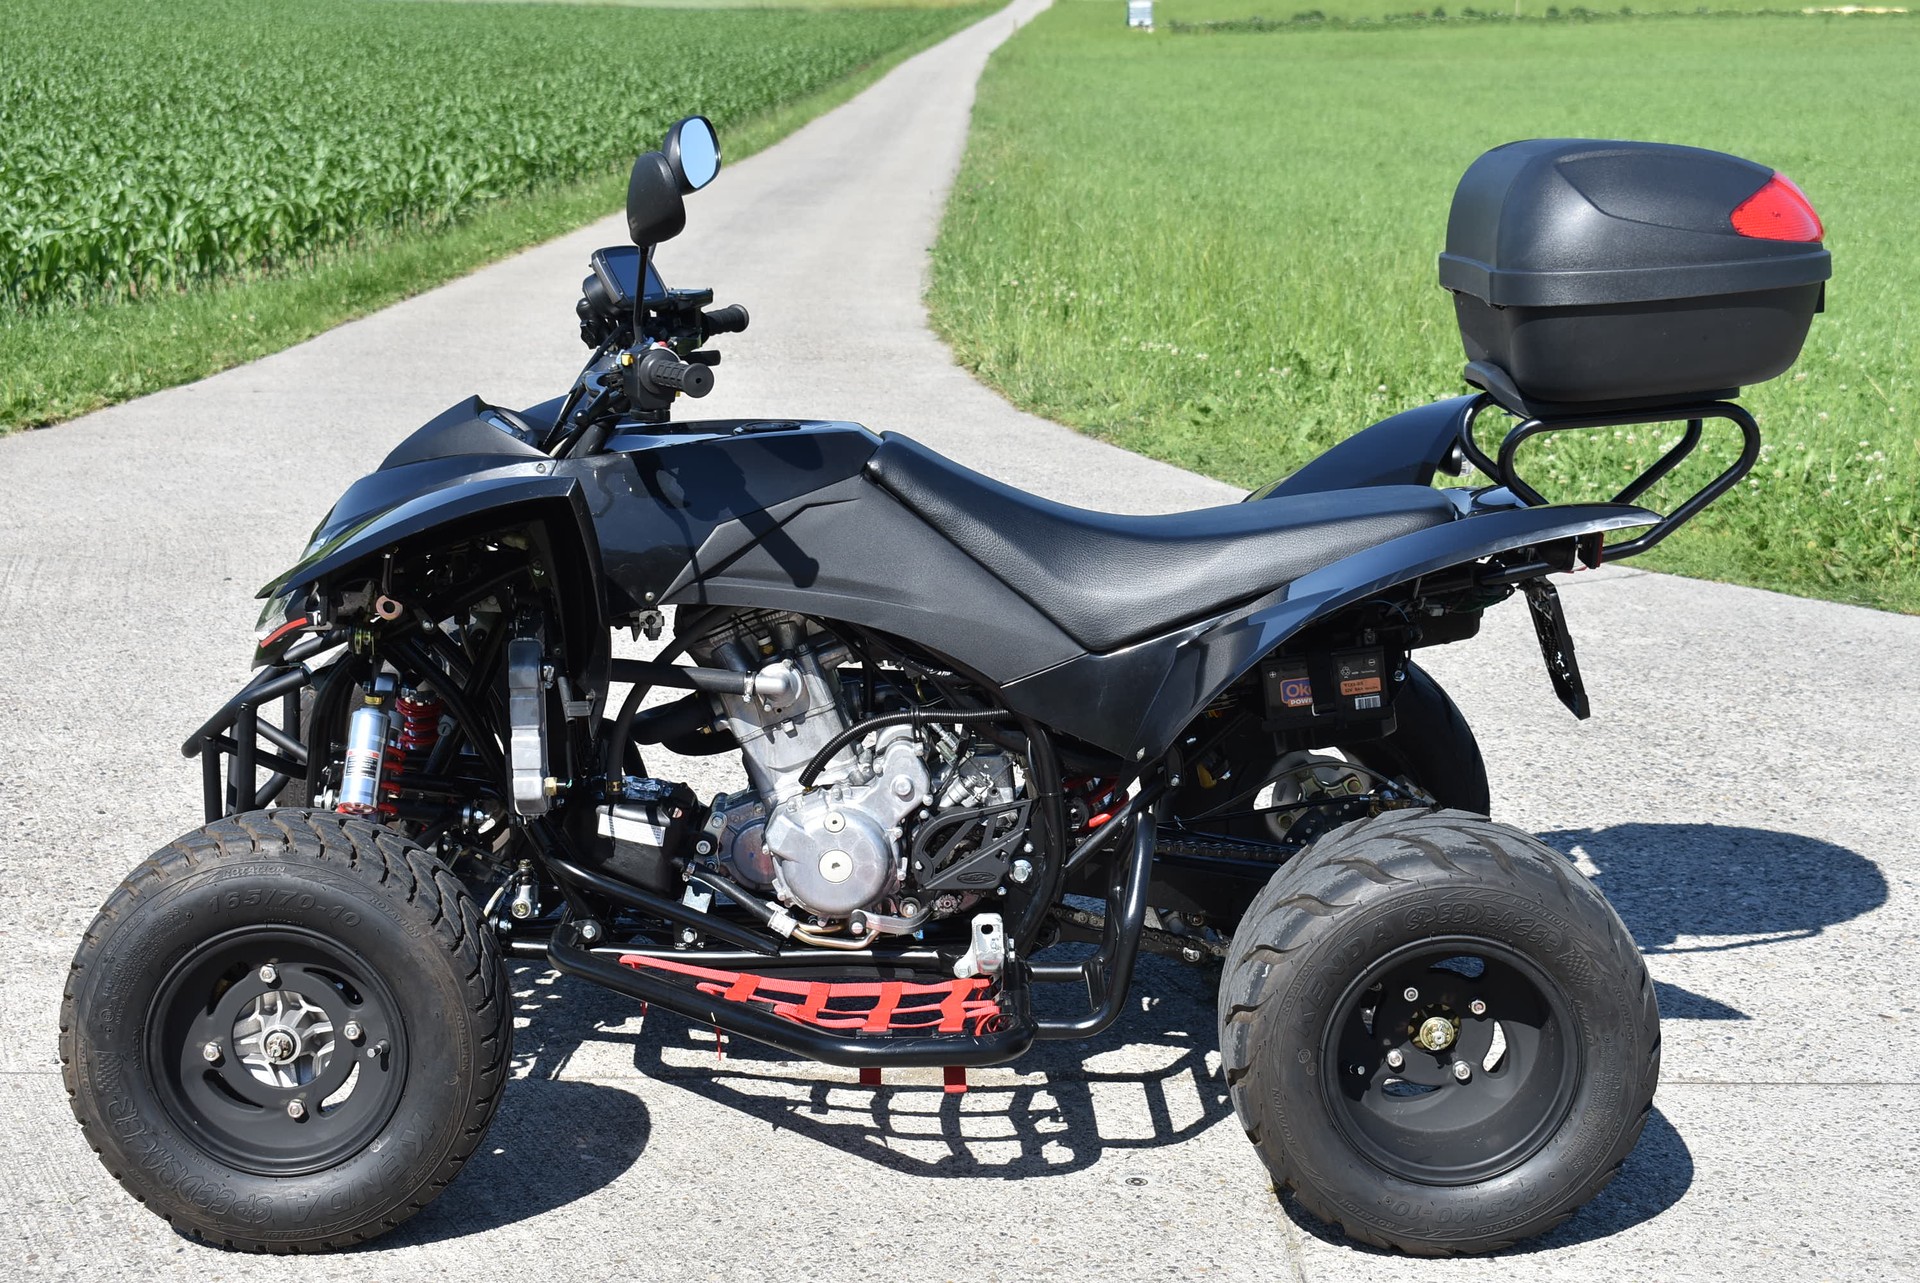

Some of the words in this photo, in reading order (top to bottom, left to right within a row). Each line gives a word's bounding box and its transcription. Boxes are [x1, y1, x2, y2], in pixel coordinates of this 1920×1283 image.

[222, 864, 287, 879] ROTATION
[207, 887, 362, 929] 165/70-10
[368, 894, 422, 939] ROTATION
[1377, 894, 1434, 915] ROTATION
[1511, 896, 1570, 931] ROTATION
[1282, 962, 1315, 1015] ROTATION
[1293, 921, 1394, 1038] KENDA
[1614, 985, 1635, 1042] ROTATION
[456, 1011, 470, 1072] ROTATION
[1271, 1087, 1296, 1146] ROTATION
[1590, 1115, 1624, 1168] ROTATION
[287, 1111, 436, 1224] KENDA
[1337, 1198, 1398, 1232] ROTATION
[1391, 1182, 1539, 1225] 225/40-10
[1472, 1212, 1531, 1235] ROTATION
[263, 1228, 323, 1239] ROTATION
